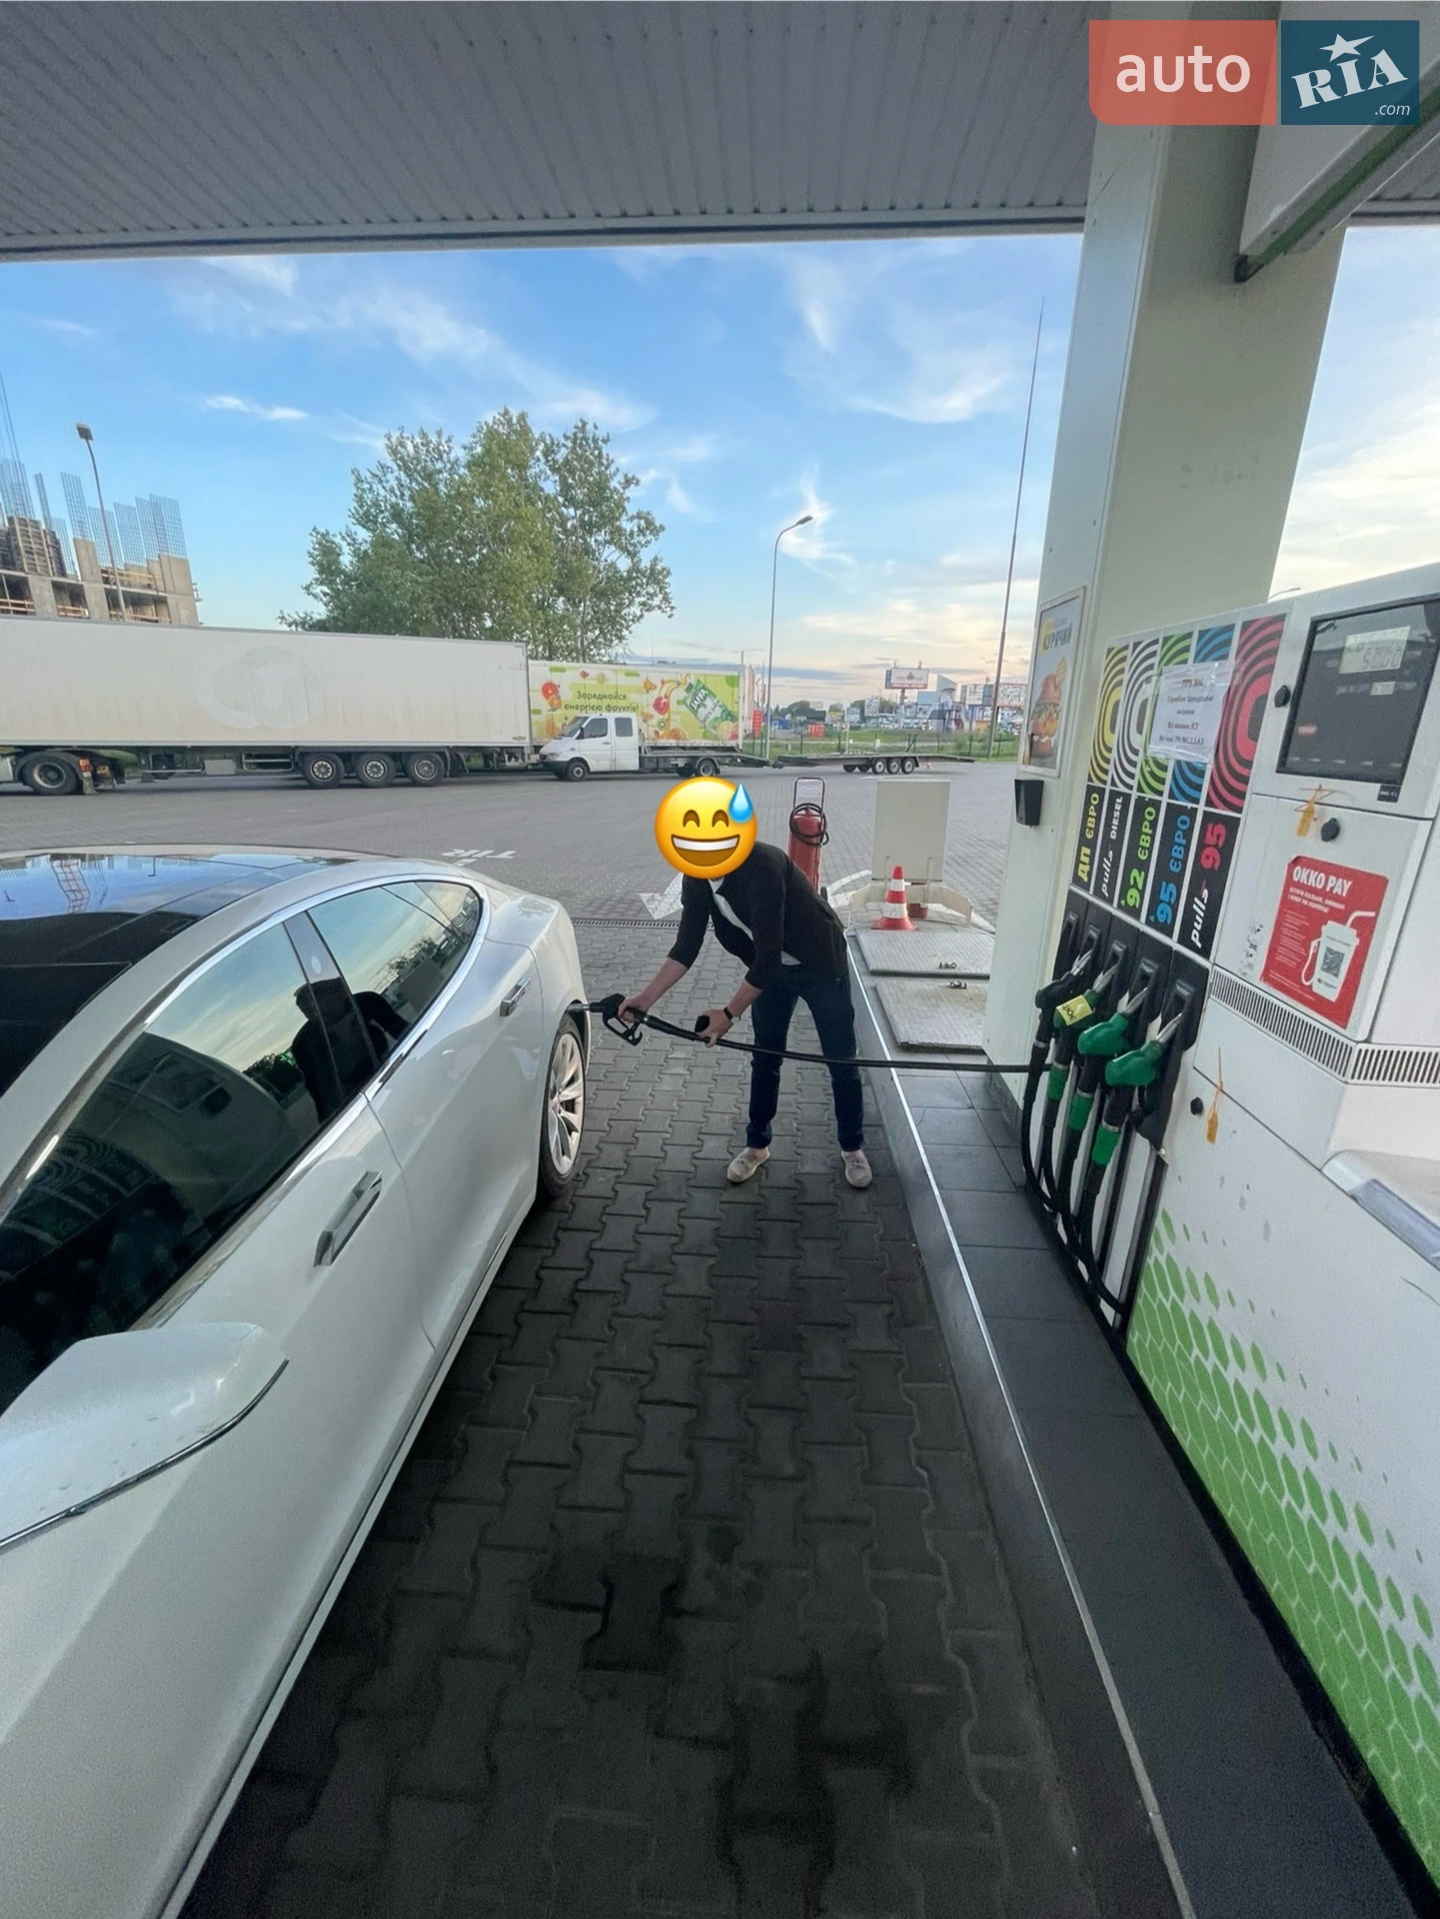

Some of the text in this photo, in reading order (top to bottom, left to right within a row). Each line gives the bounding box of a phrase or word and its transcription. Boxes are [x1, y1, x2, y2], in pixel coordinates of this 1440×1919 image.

[1077, 792, 1100, 882] ДП ЄВРО
[1110, 796, 1124, 840] DIESEL
[1200, 822, 1226, 871] 95
[1126, 868, 1145, 909] 92
[1137, 806, 1156, 861] ЄВРО
[1156, 881, 1177, 925] 95
[1169, 815, 1190, 874] ЄВРО
[1292, 866, 1352, 897] OKKO PAY
